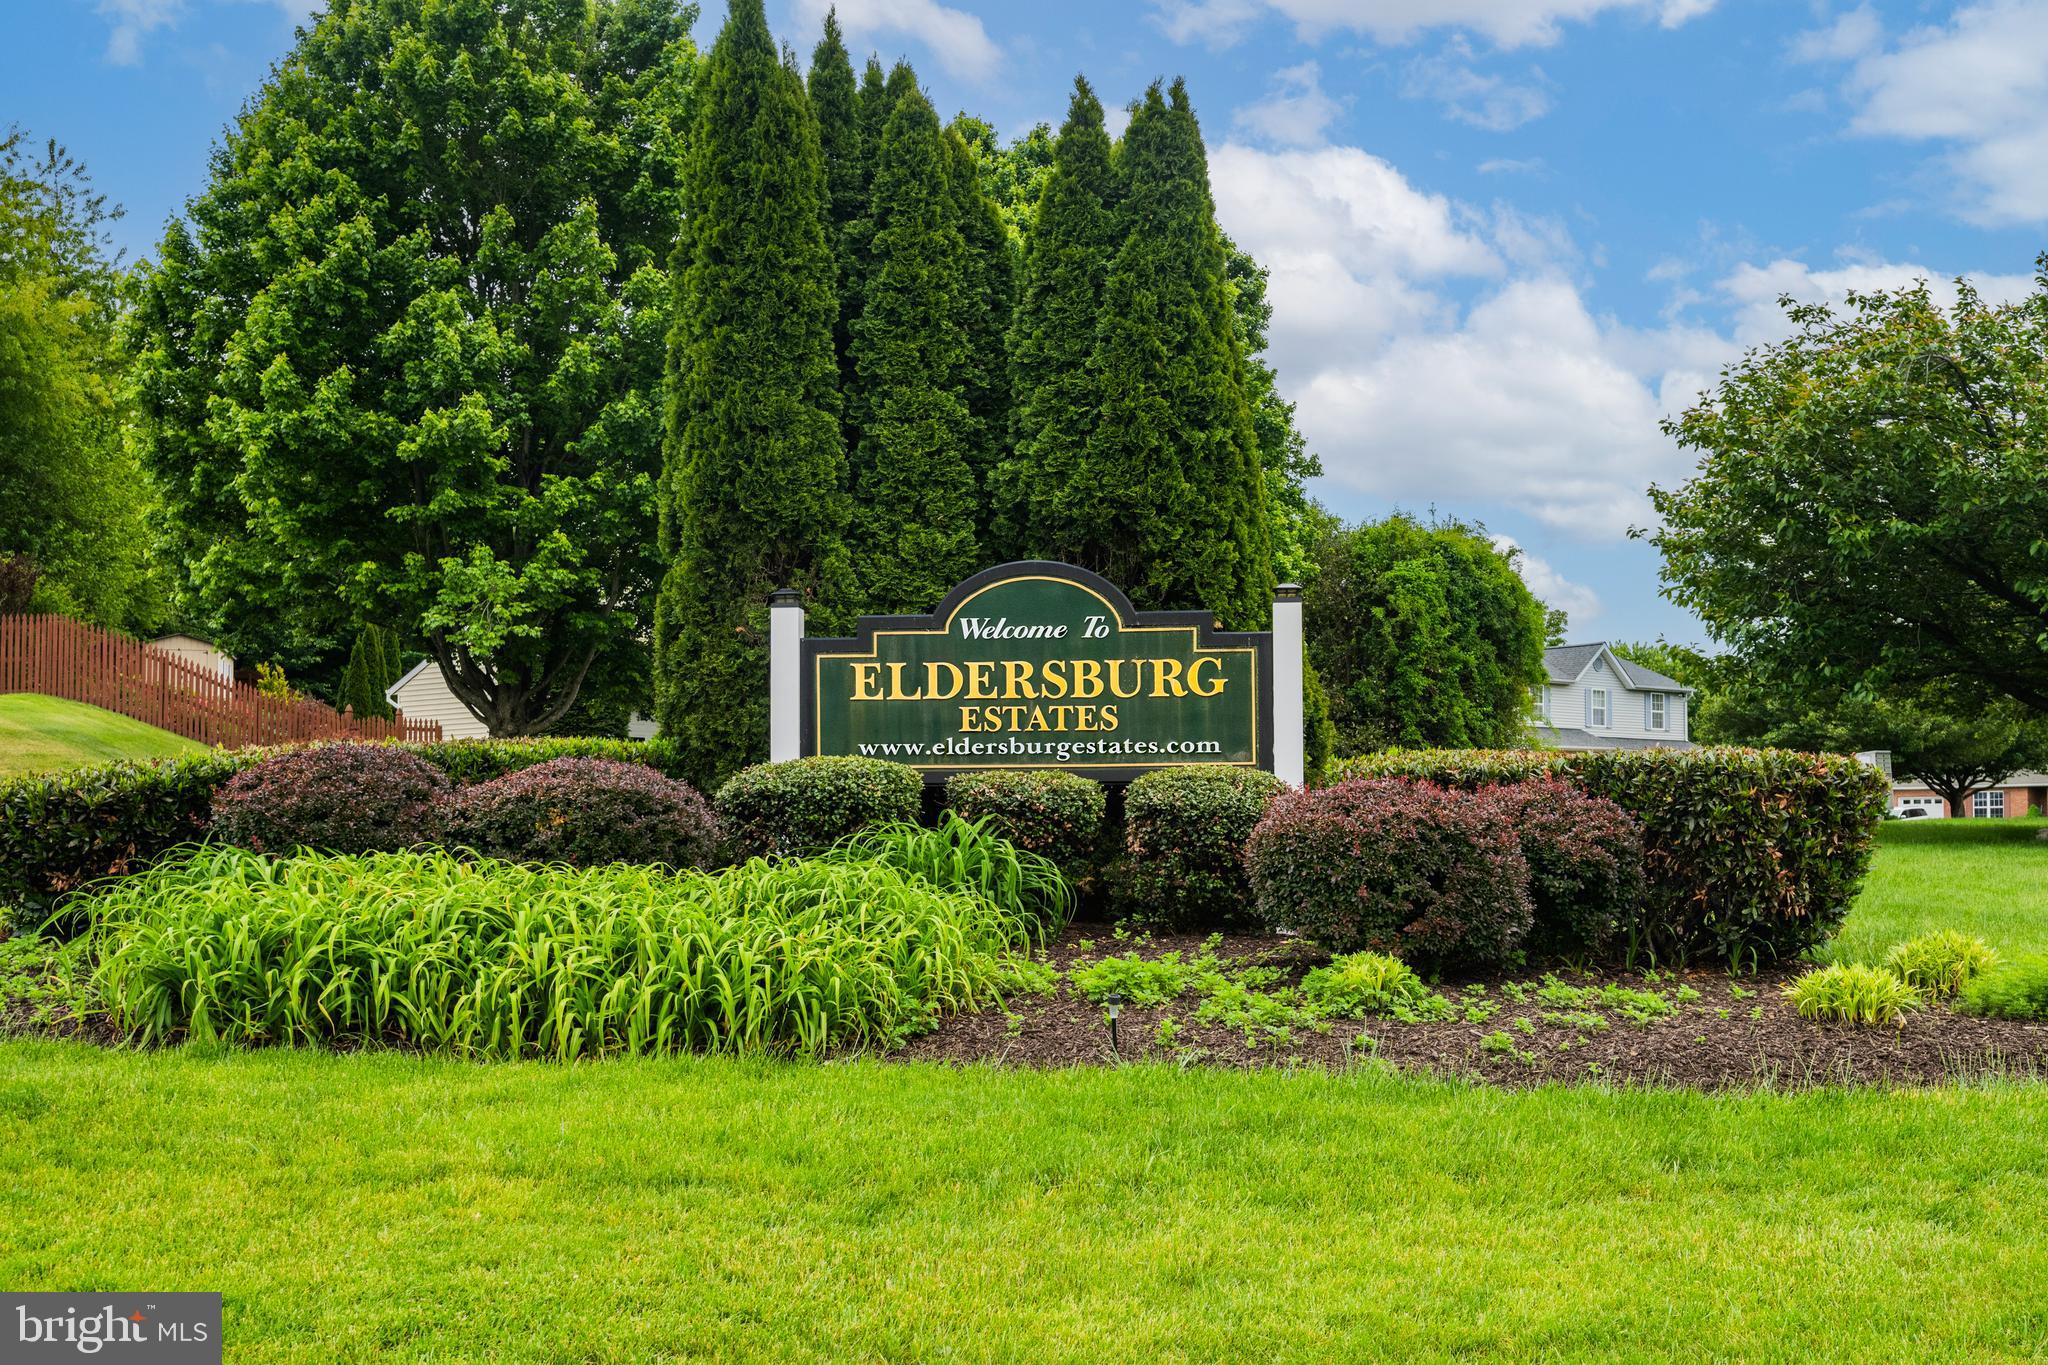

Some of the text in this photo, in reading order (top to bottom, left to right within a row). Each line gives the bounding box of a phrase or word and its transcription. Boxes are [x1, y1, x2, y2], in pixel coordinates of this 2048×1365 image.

[959, 615, 1110, 640] Welcome To
[849, 657, 1228, 701] ELDERSBURG
[958, 705, 1119, 733] ESTATES
[858, 737, 1222, 761] www.eldersburgestates.com
